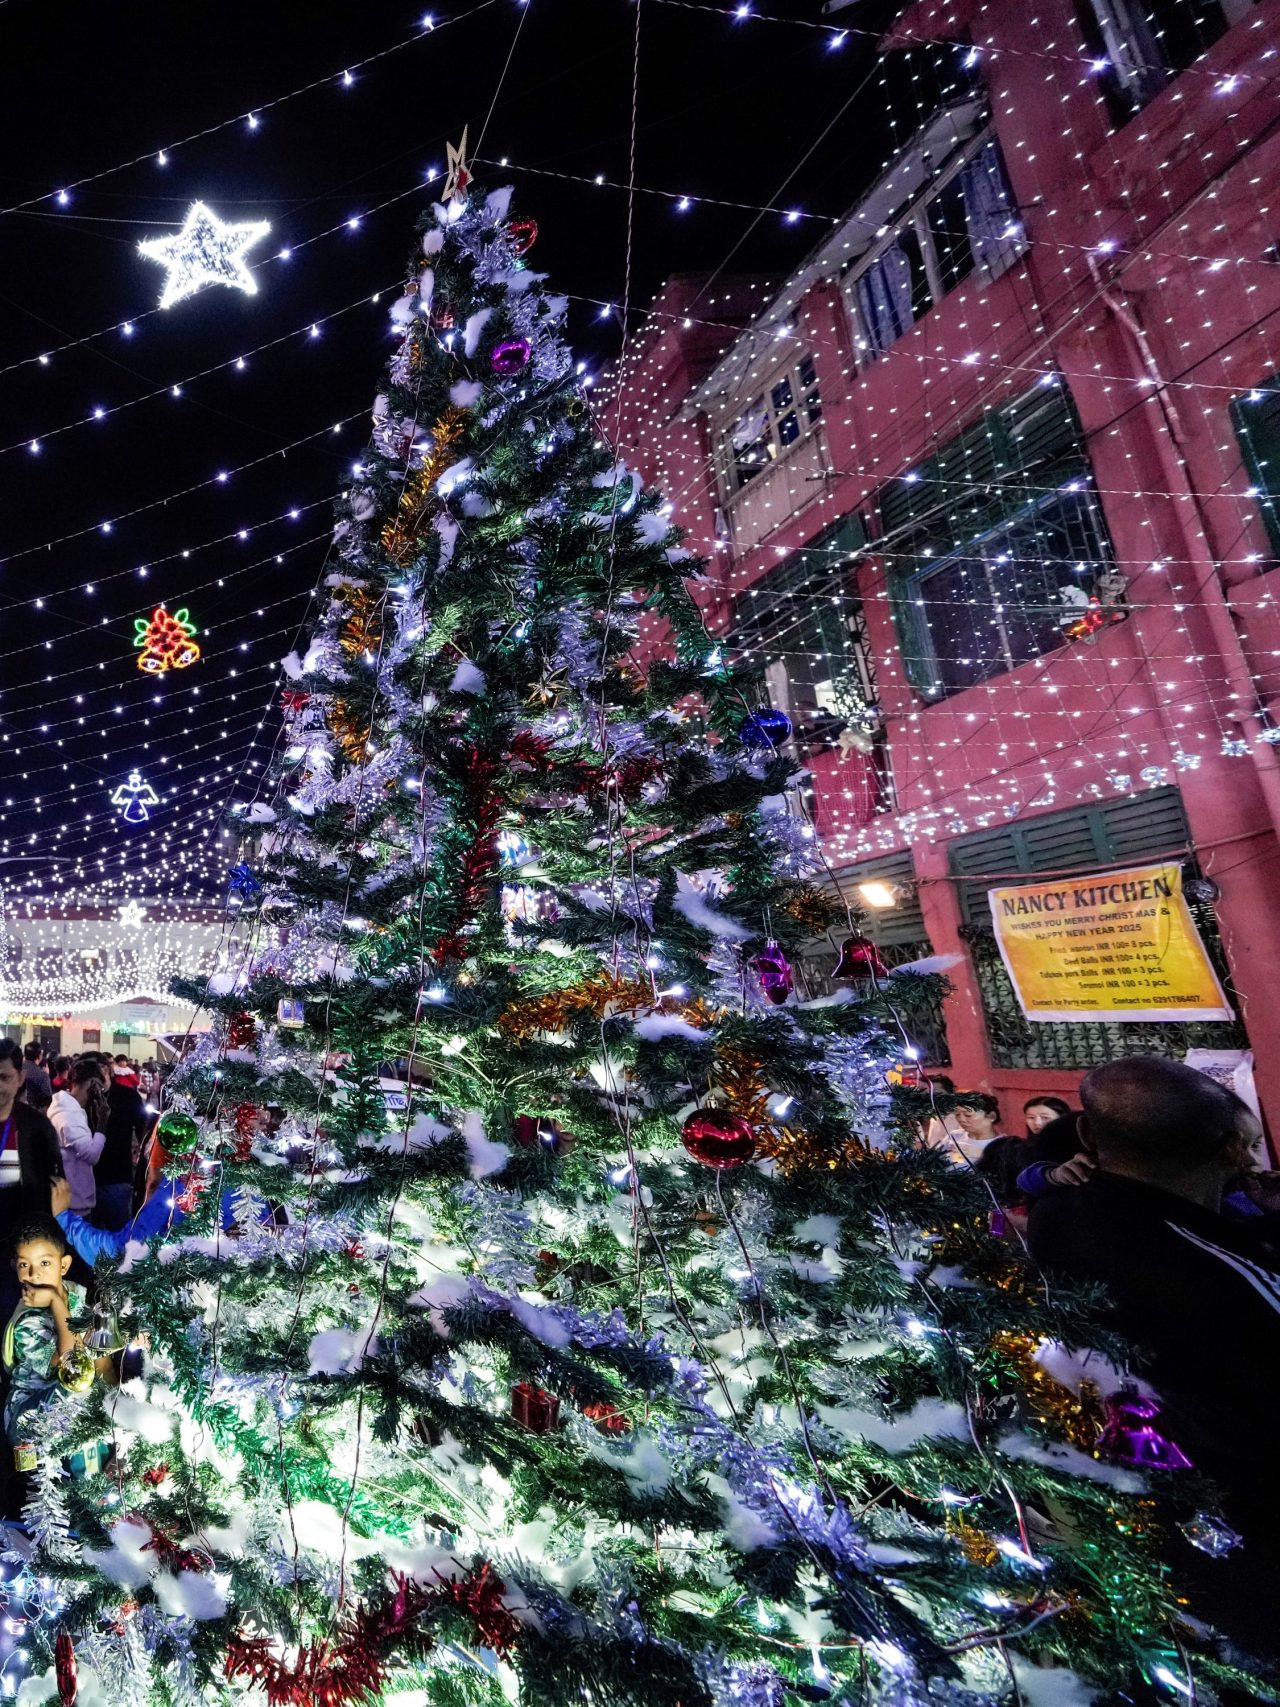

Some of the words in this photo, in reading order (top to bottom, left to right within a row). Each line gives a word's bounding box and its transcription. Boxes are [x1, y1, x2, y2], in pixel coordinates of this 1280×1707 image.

[1002, 891, 1066, 916] NANCY
[1073, 877, 1172, 908] KITCHEN
[1011, 922, 1041, 930] WISHES
[1064, 916, 1095, 925] MERRY
[1035, 931, 1063, 940] HAPPY
[1119, 924, 1142, 932] 2025
